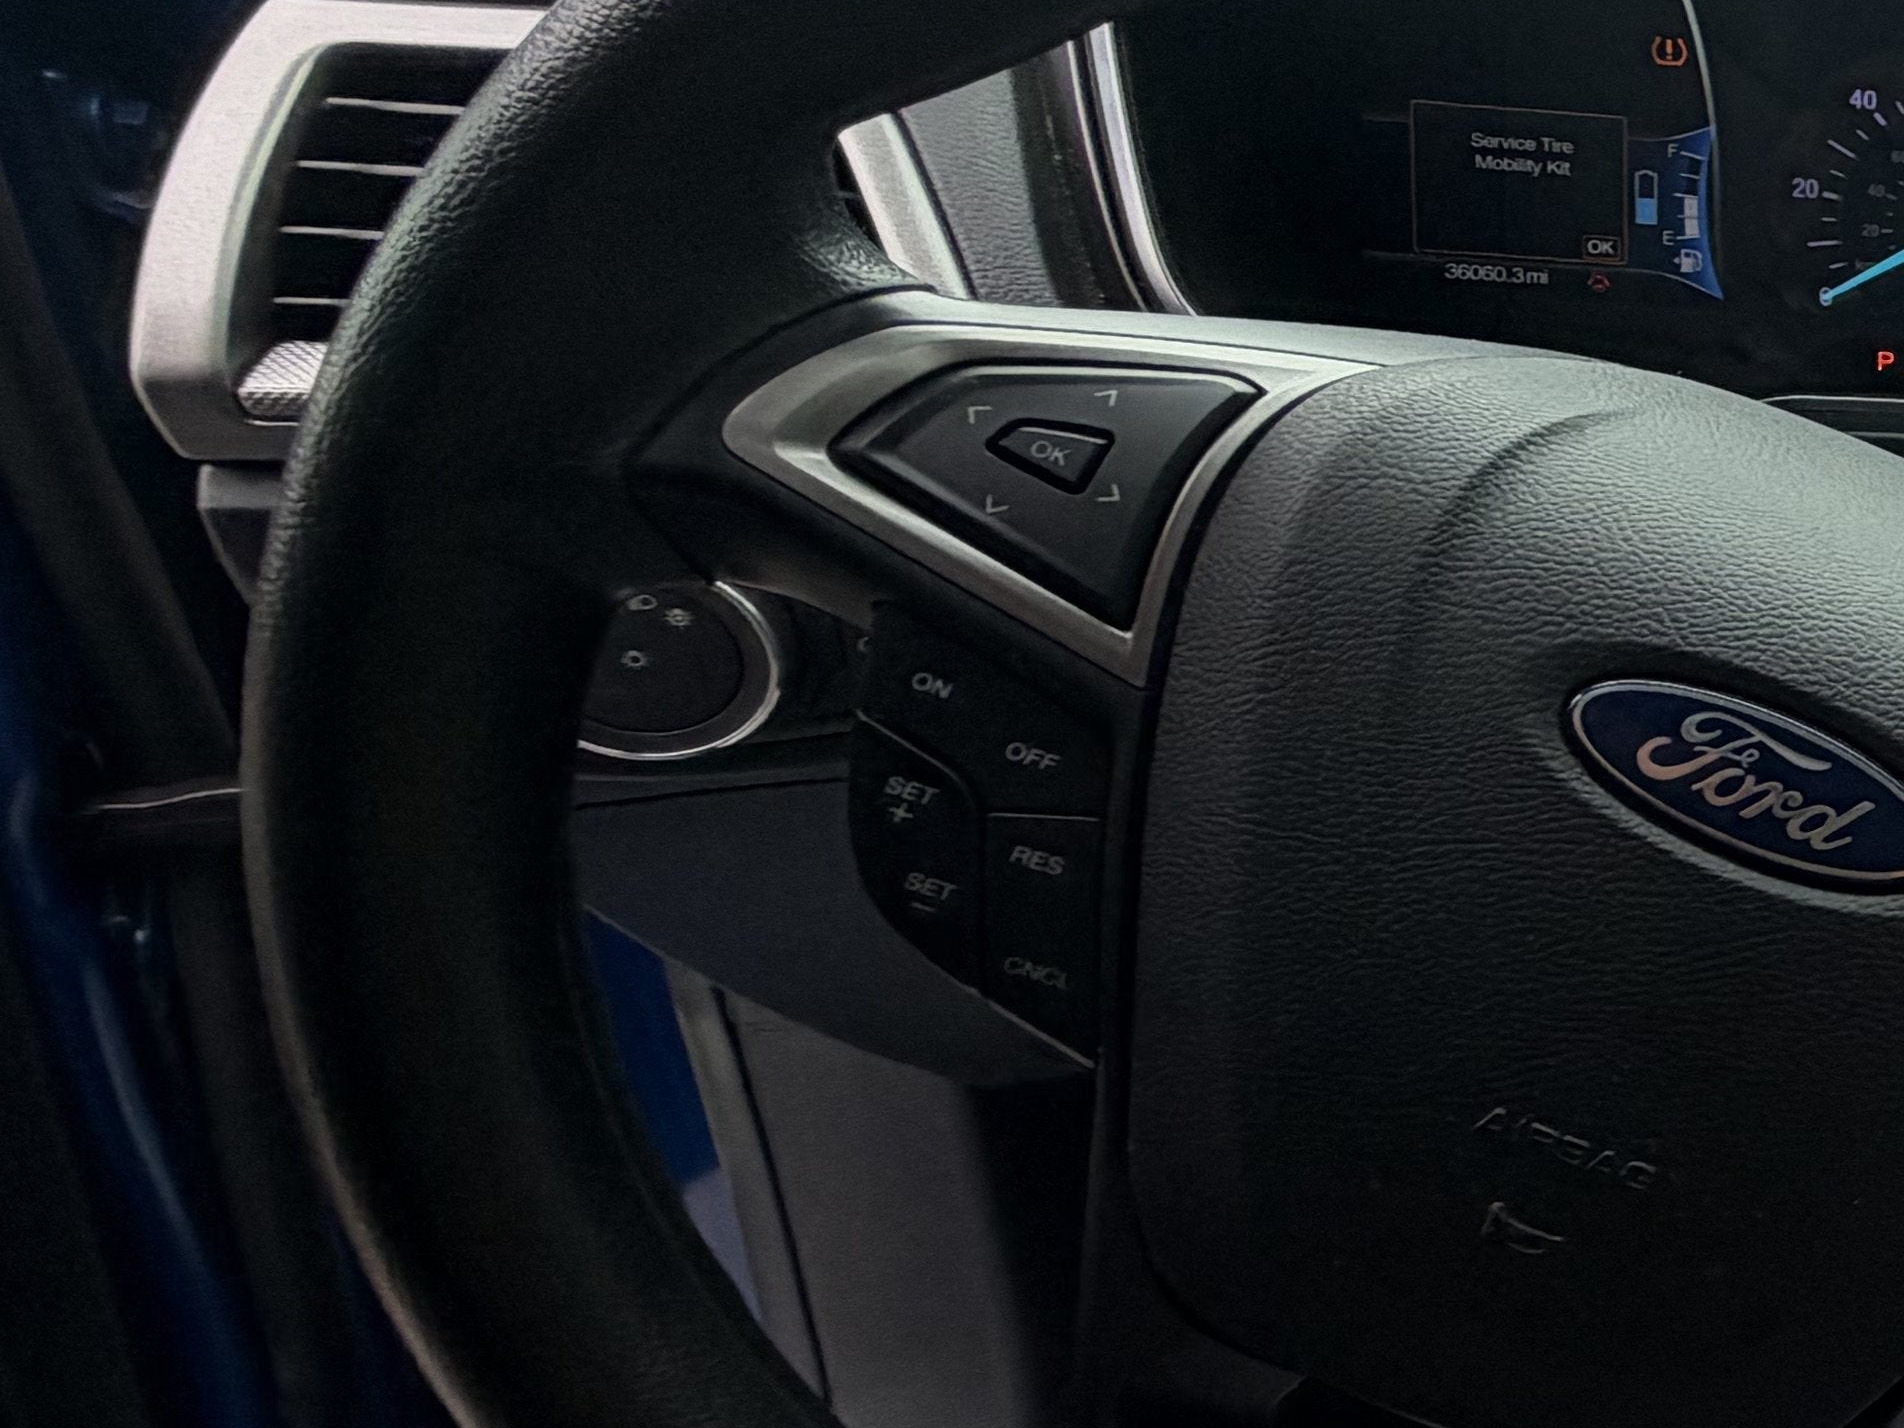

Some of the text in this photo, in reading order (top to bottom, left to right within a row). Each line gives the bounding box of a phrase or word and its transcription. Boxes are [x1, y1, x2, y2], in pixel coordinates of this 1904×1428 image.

[1849, 89, 1878, 110] 40
[1470, 132, 1576, 154] Service Tire
[1667, 144, 1678, 158] F
[1474, 154, 1572, 177] Mobility Kit
[1791, 177, 1820, 199] 20
[1587, 239, 1615, 255] OK
[1663, 231, 1676, 245] E
[1877, 351, 1894, 371] P
[1030, 439, 1073, 467] OK
[911, 673, 952, 700] ON
[1005, 742, 1061, 772] OFF
[884, 777, 940, 805] SET
[1637, 711, 1875, 850] Ford
[1009, 845, 1066, 875] RES
[905, 872, 957, 901] SET
